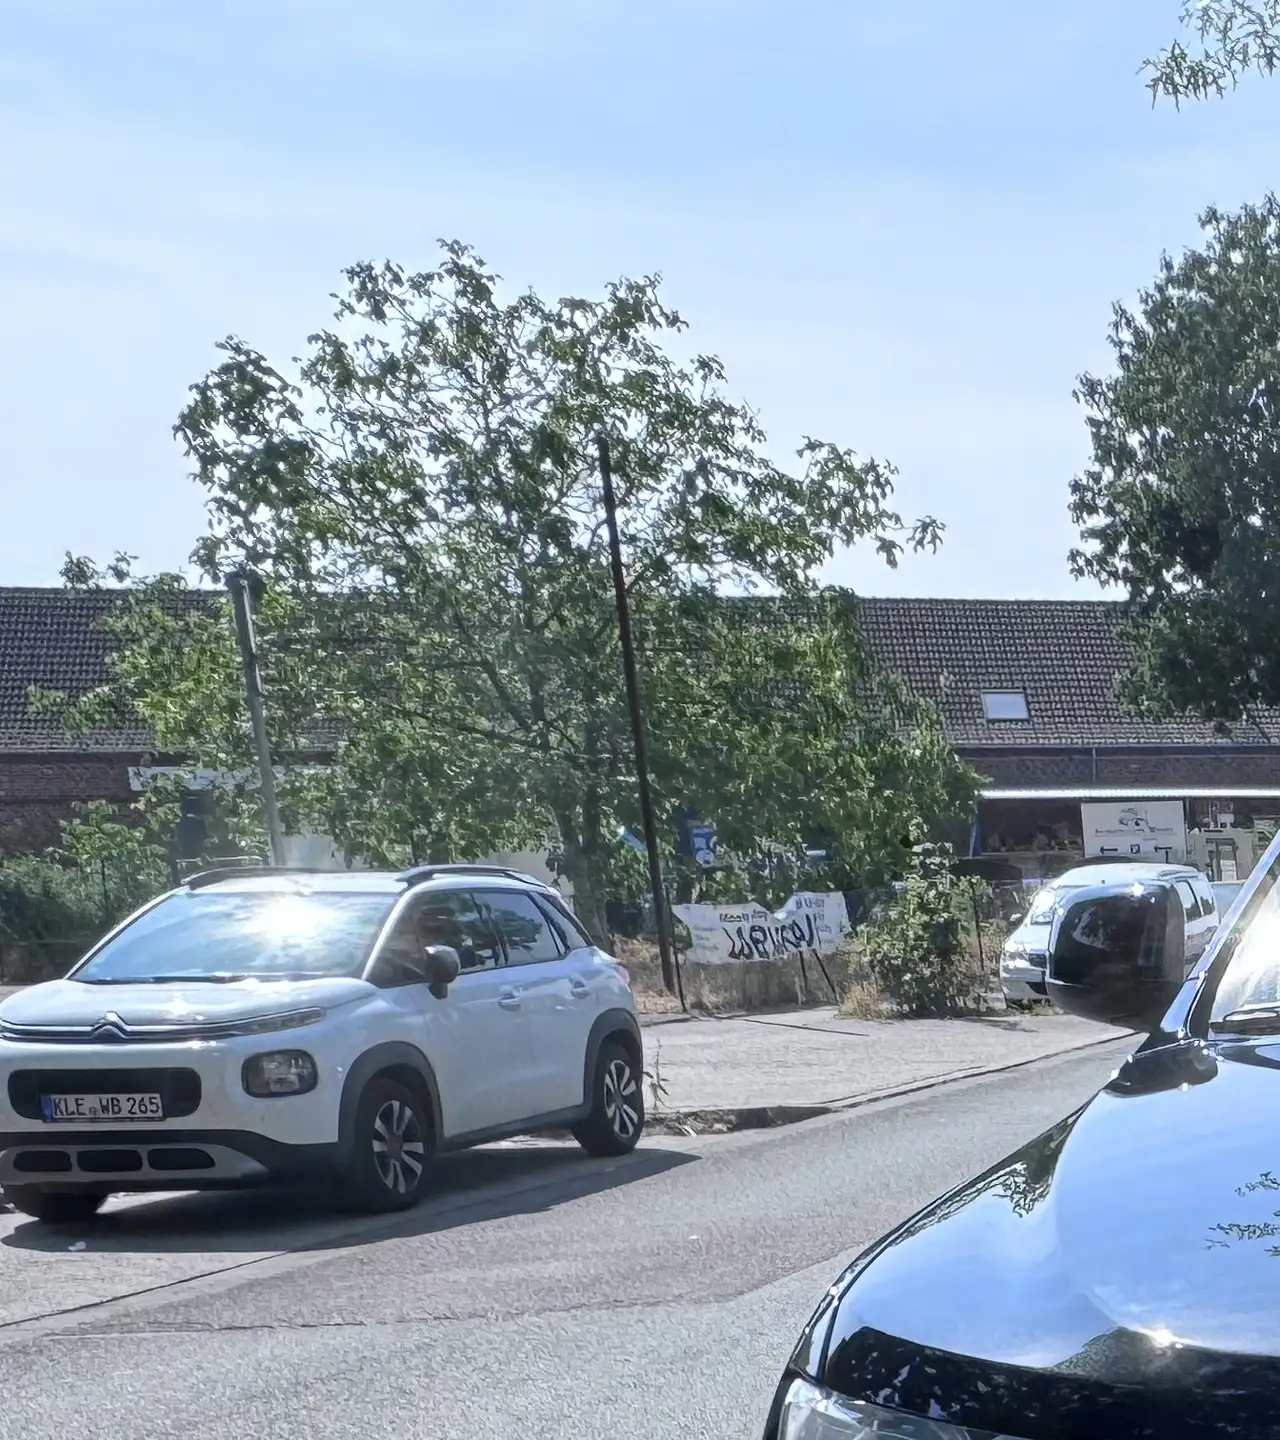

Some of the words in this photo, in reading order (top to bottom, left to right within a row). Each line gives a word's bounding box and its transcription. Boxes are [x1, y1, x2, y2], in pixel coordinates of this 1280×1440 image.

[53, 1097, 86, 1117] KLE
[99, 1096, 122, 1116] WB
[126, 1095, 161, 1115] 265
